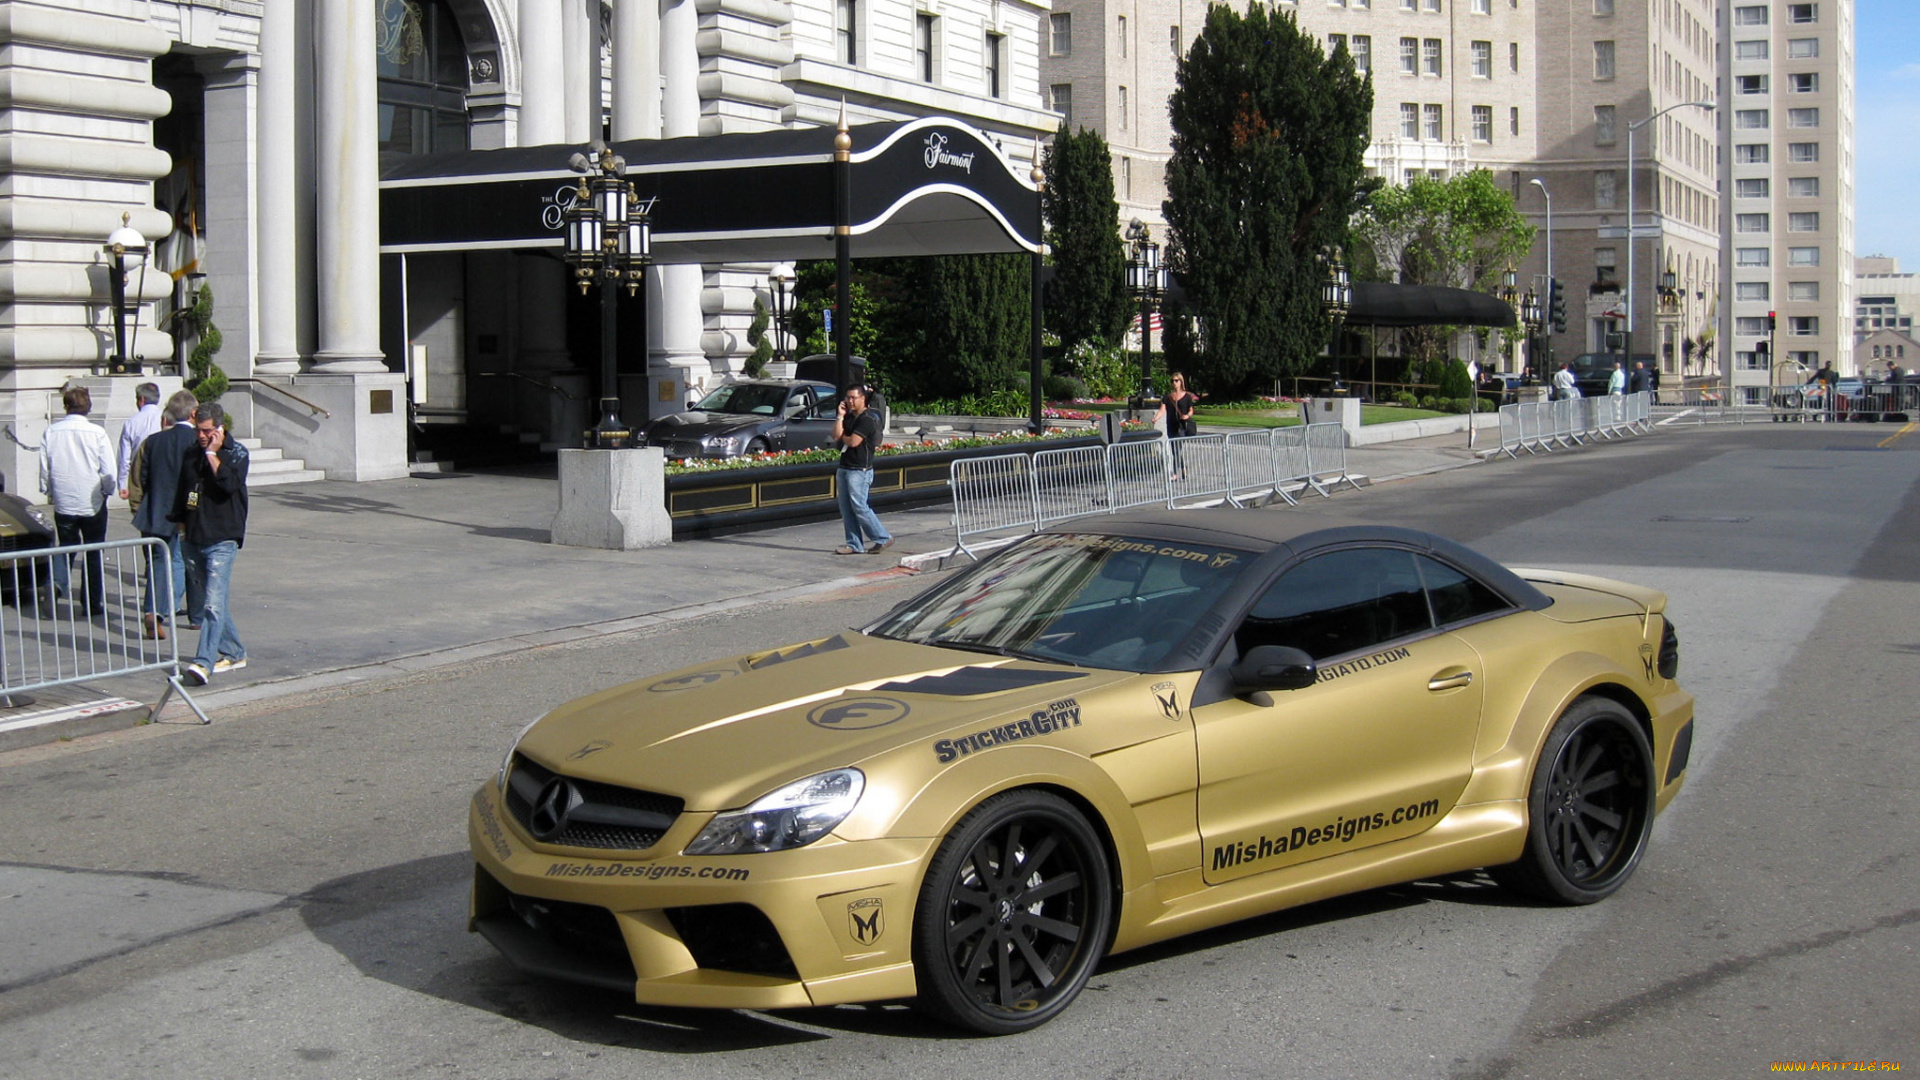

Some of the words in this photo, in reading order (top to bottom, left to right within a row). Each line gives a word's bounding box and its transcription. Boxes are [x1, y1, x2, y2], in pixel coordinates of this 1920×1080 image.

[924, 132, 975, 174] Fairmont
[1036, 536, 1208, 562] Designs.com
[1212, 798, 1439, 871] MishaDesigns.com
[545, 862, 750, 881] MishaDesigns.com
